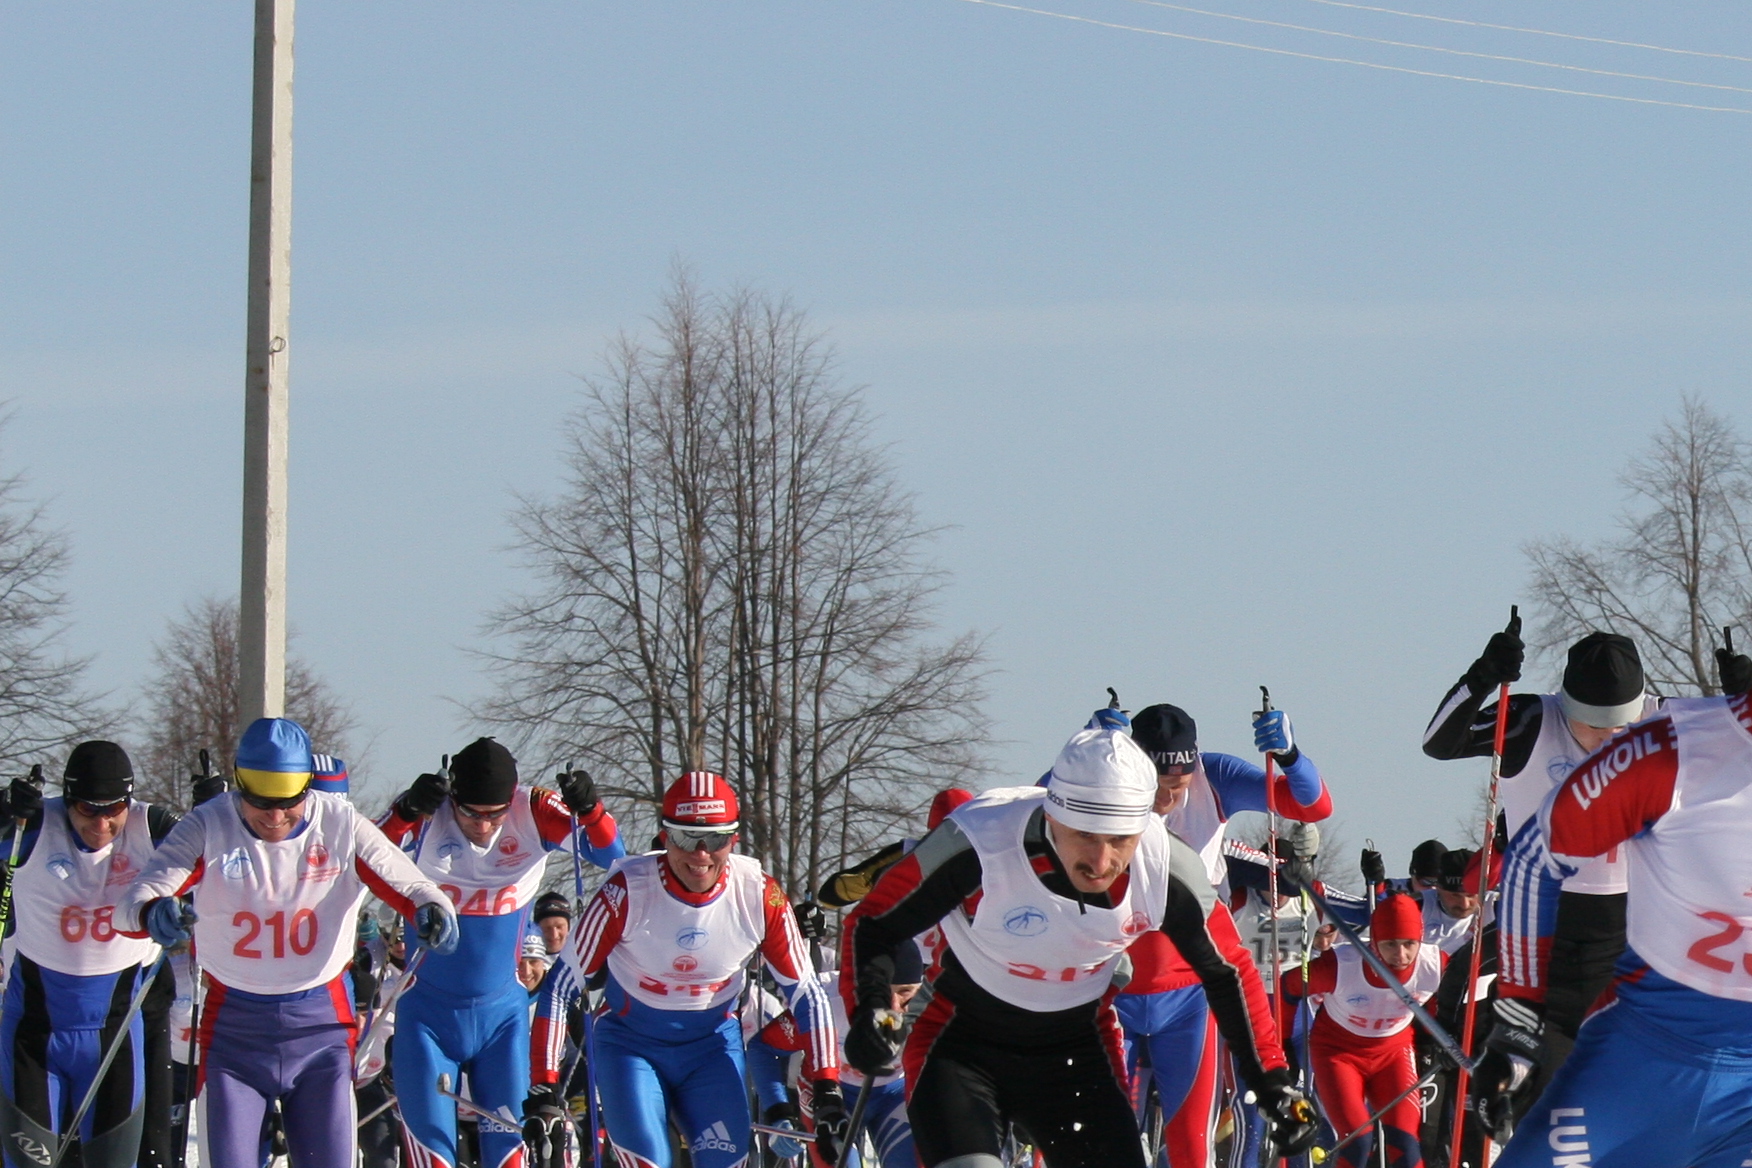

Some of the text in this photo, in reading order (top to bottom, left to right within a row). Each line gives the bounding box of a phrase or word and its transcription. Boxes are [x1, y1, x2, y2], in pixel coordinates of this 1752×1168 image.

[1571, 730, 1662, 811] LUKOIL
[60, 905, 116, 944] 68
[232, 908, 319, 959] 210
